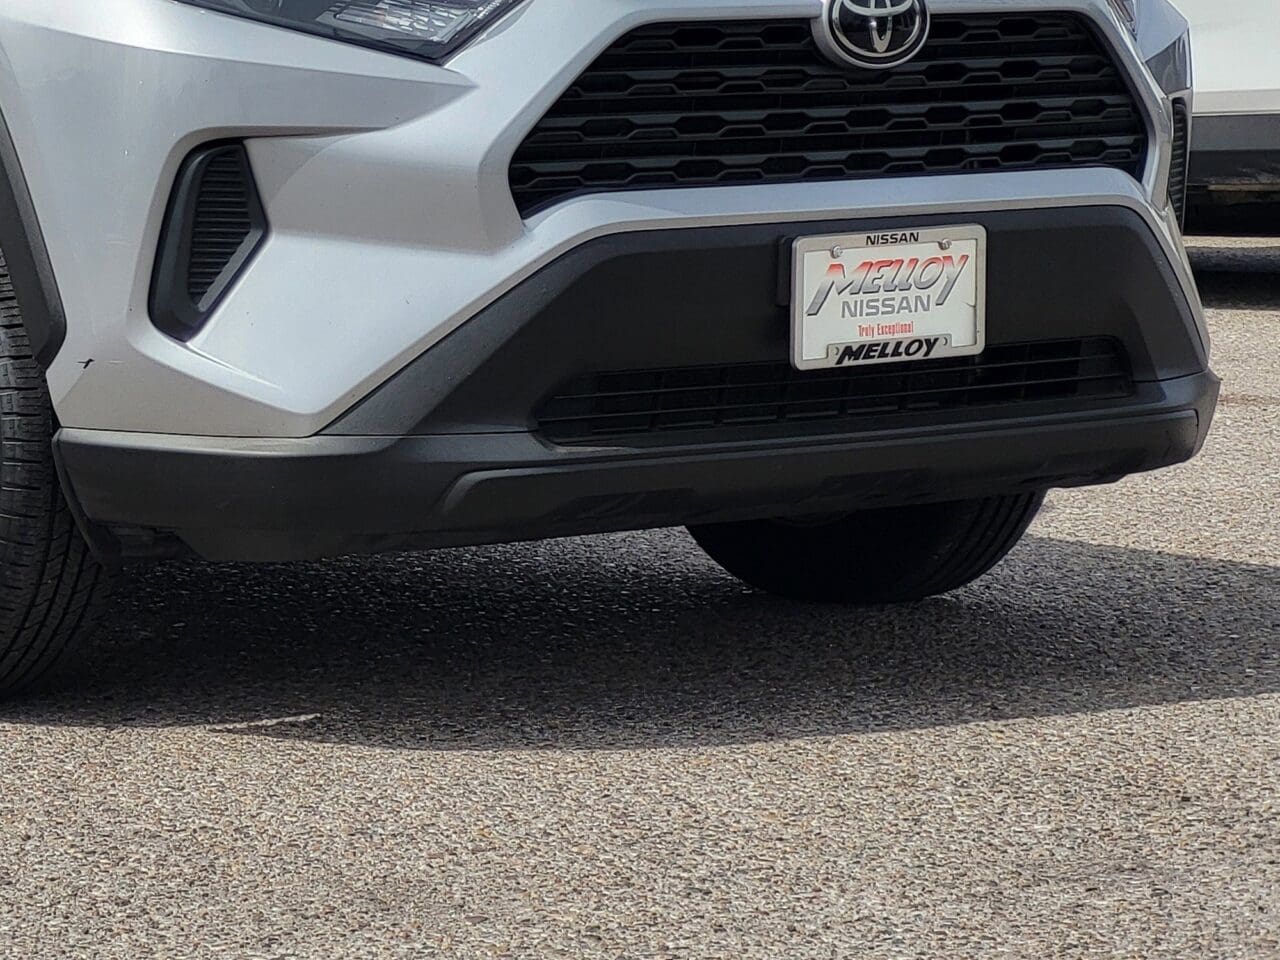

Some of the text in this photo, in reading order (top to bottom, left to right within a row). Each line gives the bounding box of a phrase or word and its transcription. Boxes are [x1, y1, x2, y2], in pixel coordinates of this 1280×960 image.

[865, 231, 920, 246] NISSAN
[806, 254, 969, 316] MELLOY
[841, 294, 931, 319] NISSAN
[858, 324, 875, 338] Truly
[835, 337, 939, 365] MELLOY
